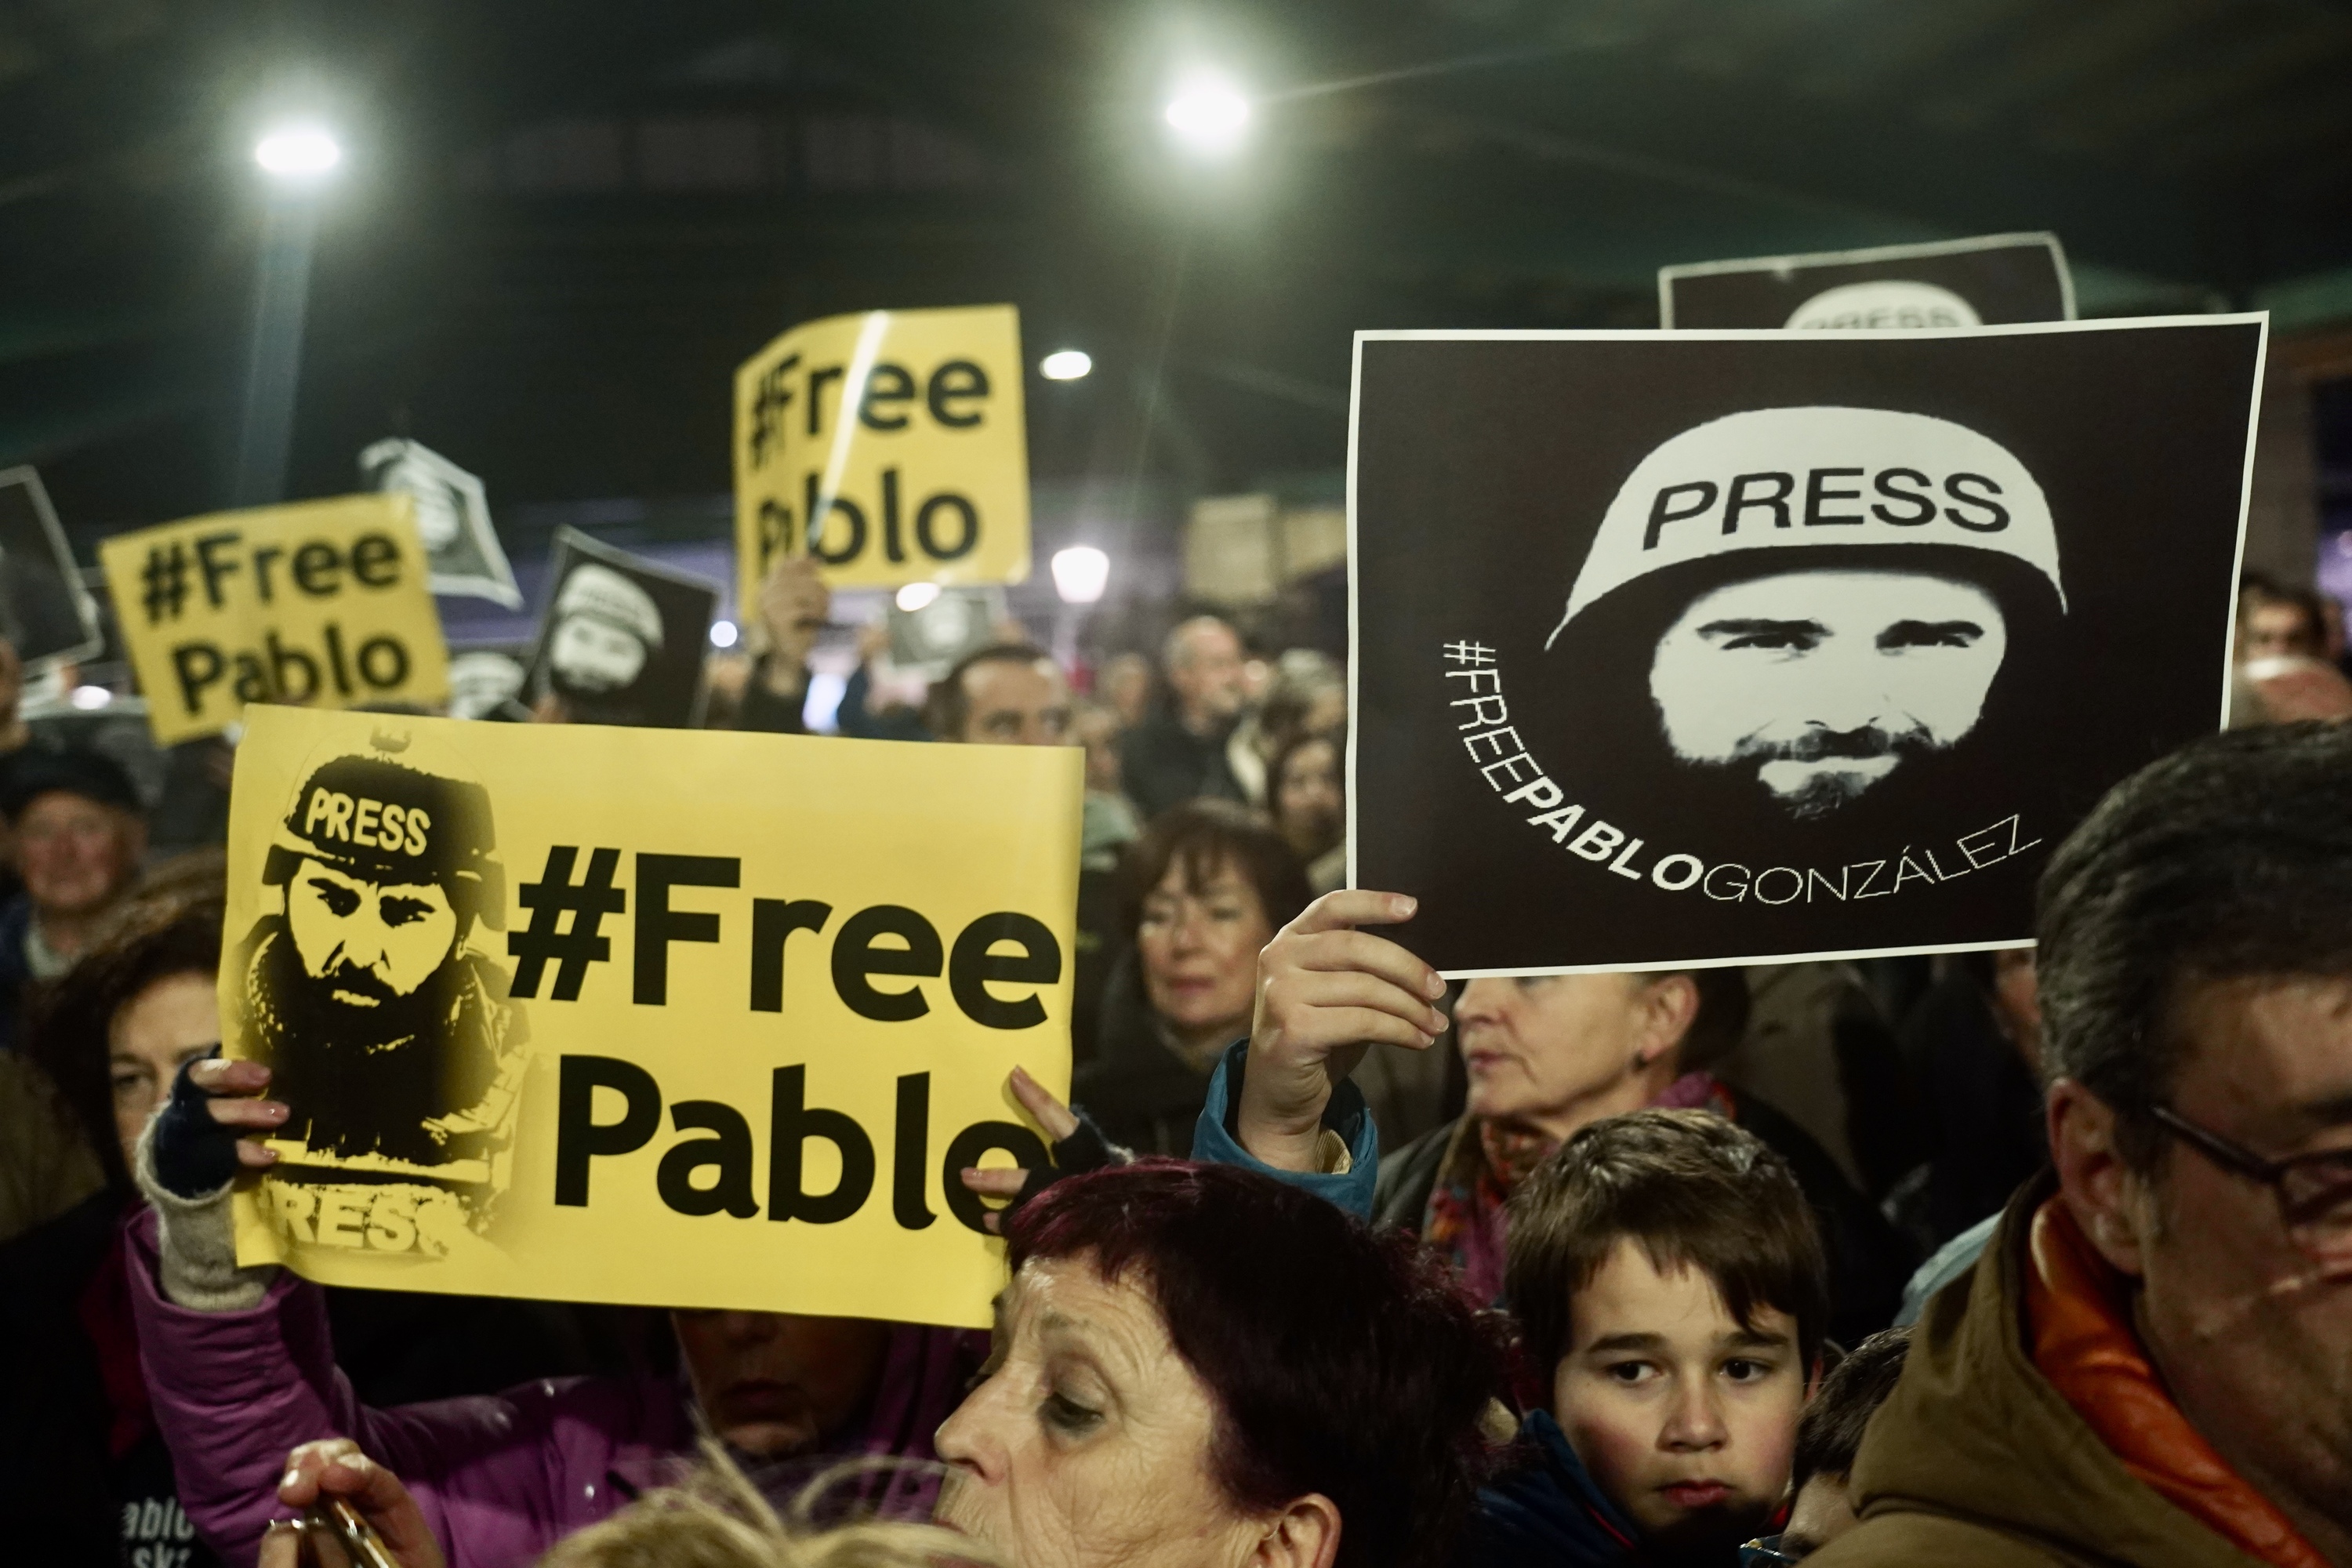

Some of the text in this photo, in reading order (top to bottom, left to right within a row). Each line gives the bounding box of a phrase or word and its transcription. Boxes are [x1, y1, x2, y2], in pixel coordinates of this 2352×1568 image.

[750, 351, 990, 469] #Free
[1642, 467, 2010, 551] PRESS
[140, 532, 401, 625] #Free
[171, 622, 412, 717] Pablo
[305, 786, 431, 856] PRESS
[507, 845, 1062, 1029] #Free
[554, 1054, 1052, 1236] Pablo
